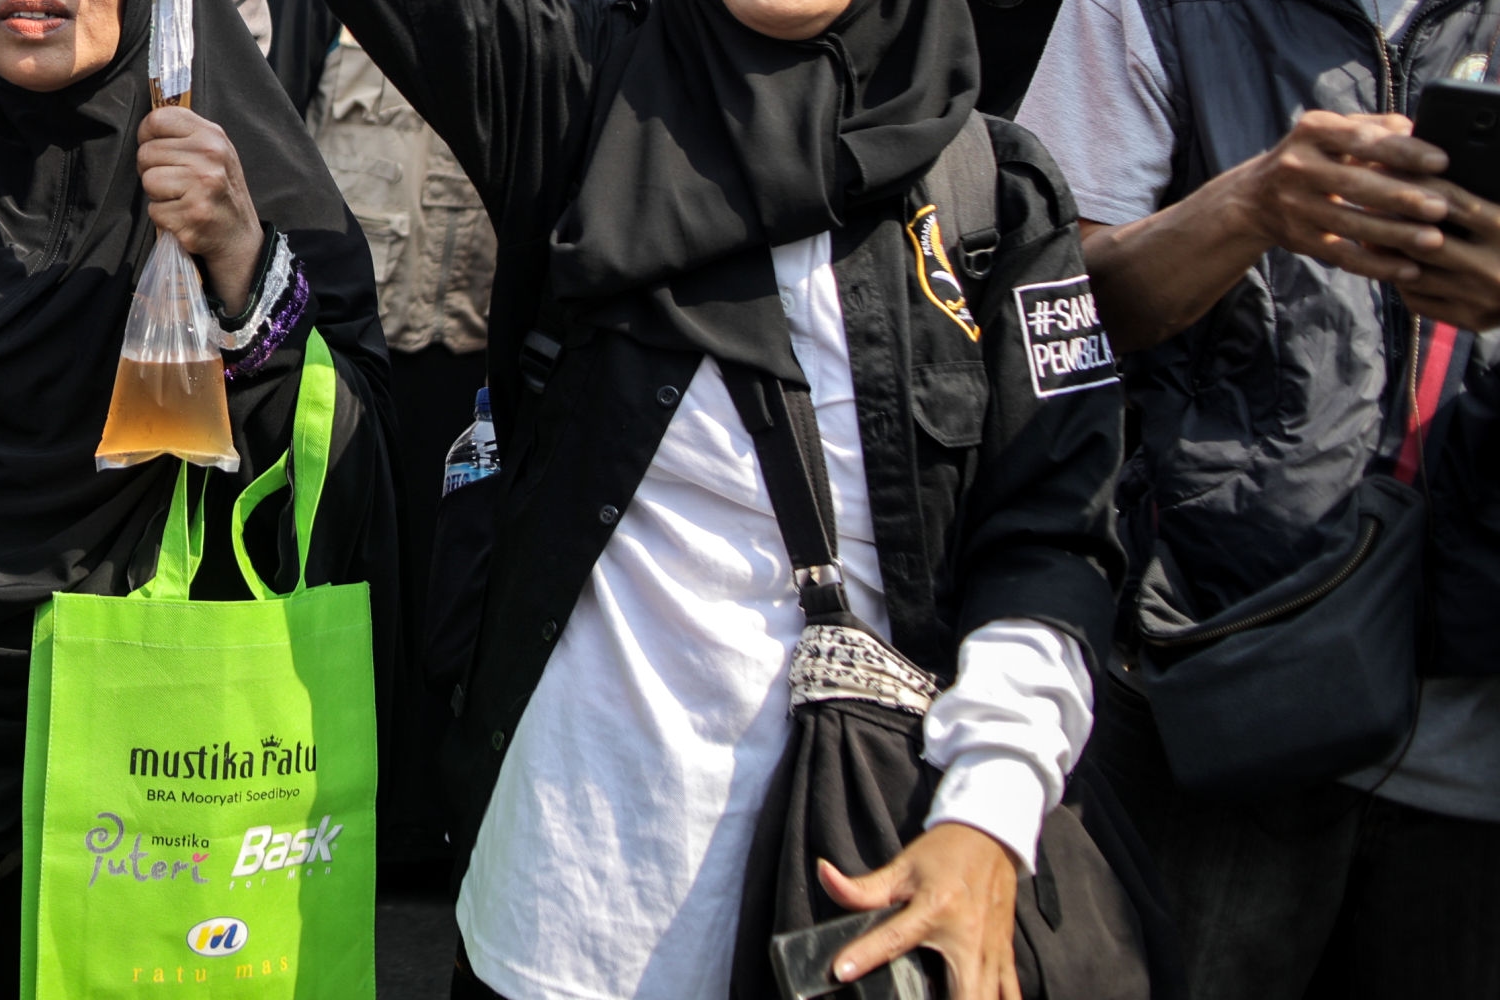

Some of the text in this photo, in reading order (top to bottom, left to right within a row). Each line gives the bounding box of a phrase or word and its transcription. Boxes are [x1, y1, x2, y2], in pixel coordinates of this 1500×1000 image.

[129, 740, 317, 781] mustika ratu
[147, 788, 300, 806] BRA Mooryati Soedibyo
[151, 833, 210, 849] mustika
[230, 814, 344, 878] Bask
[287, 866, 332, 880] Men
[132, 955, 289, 984] ratu mas
